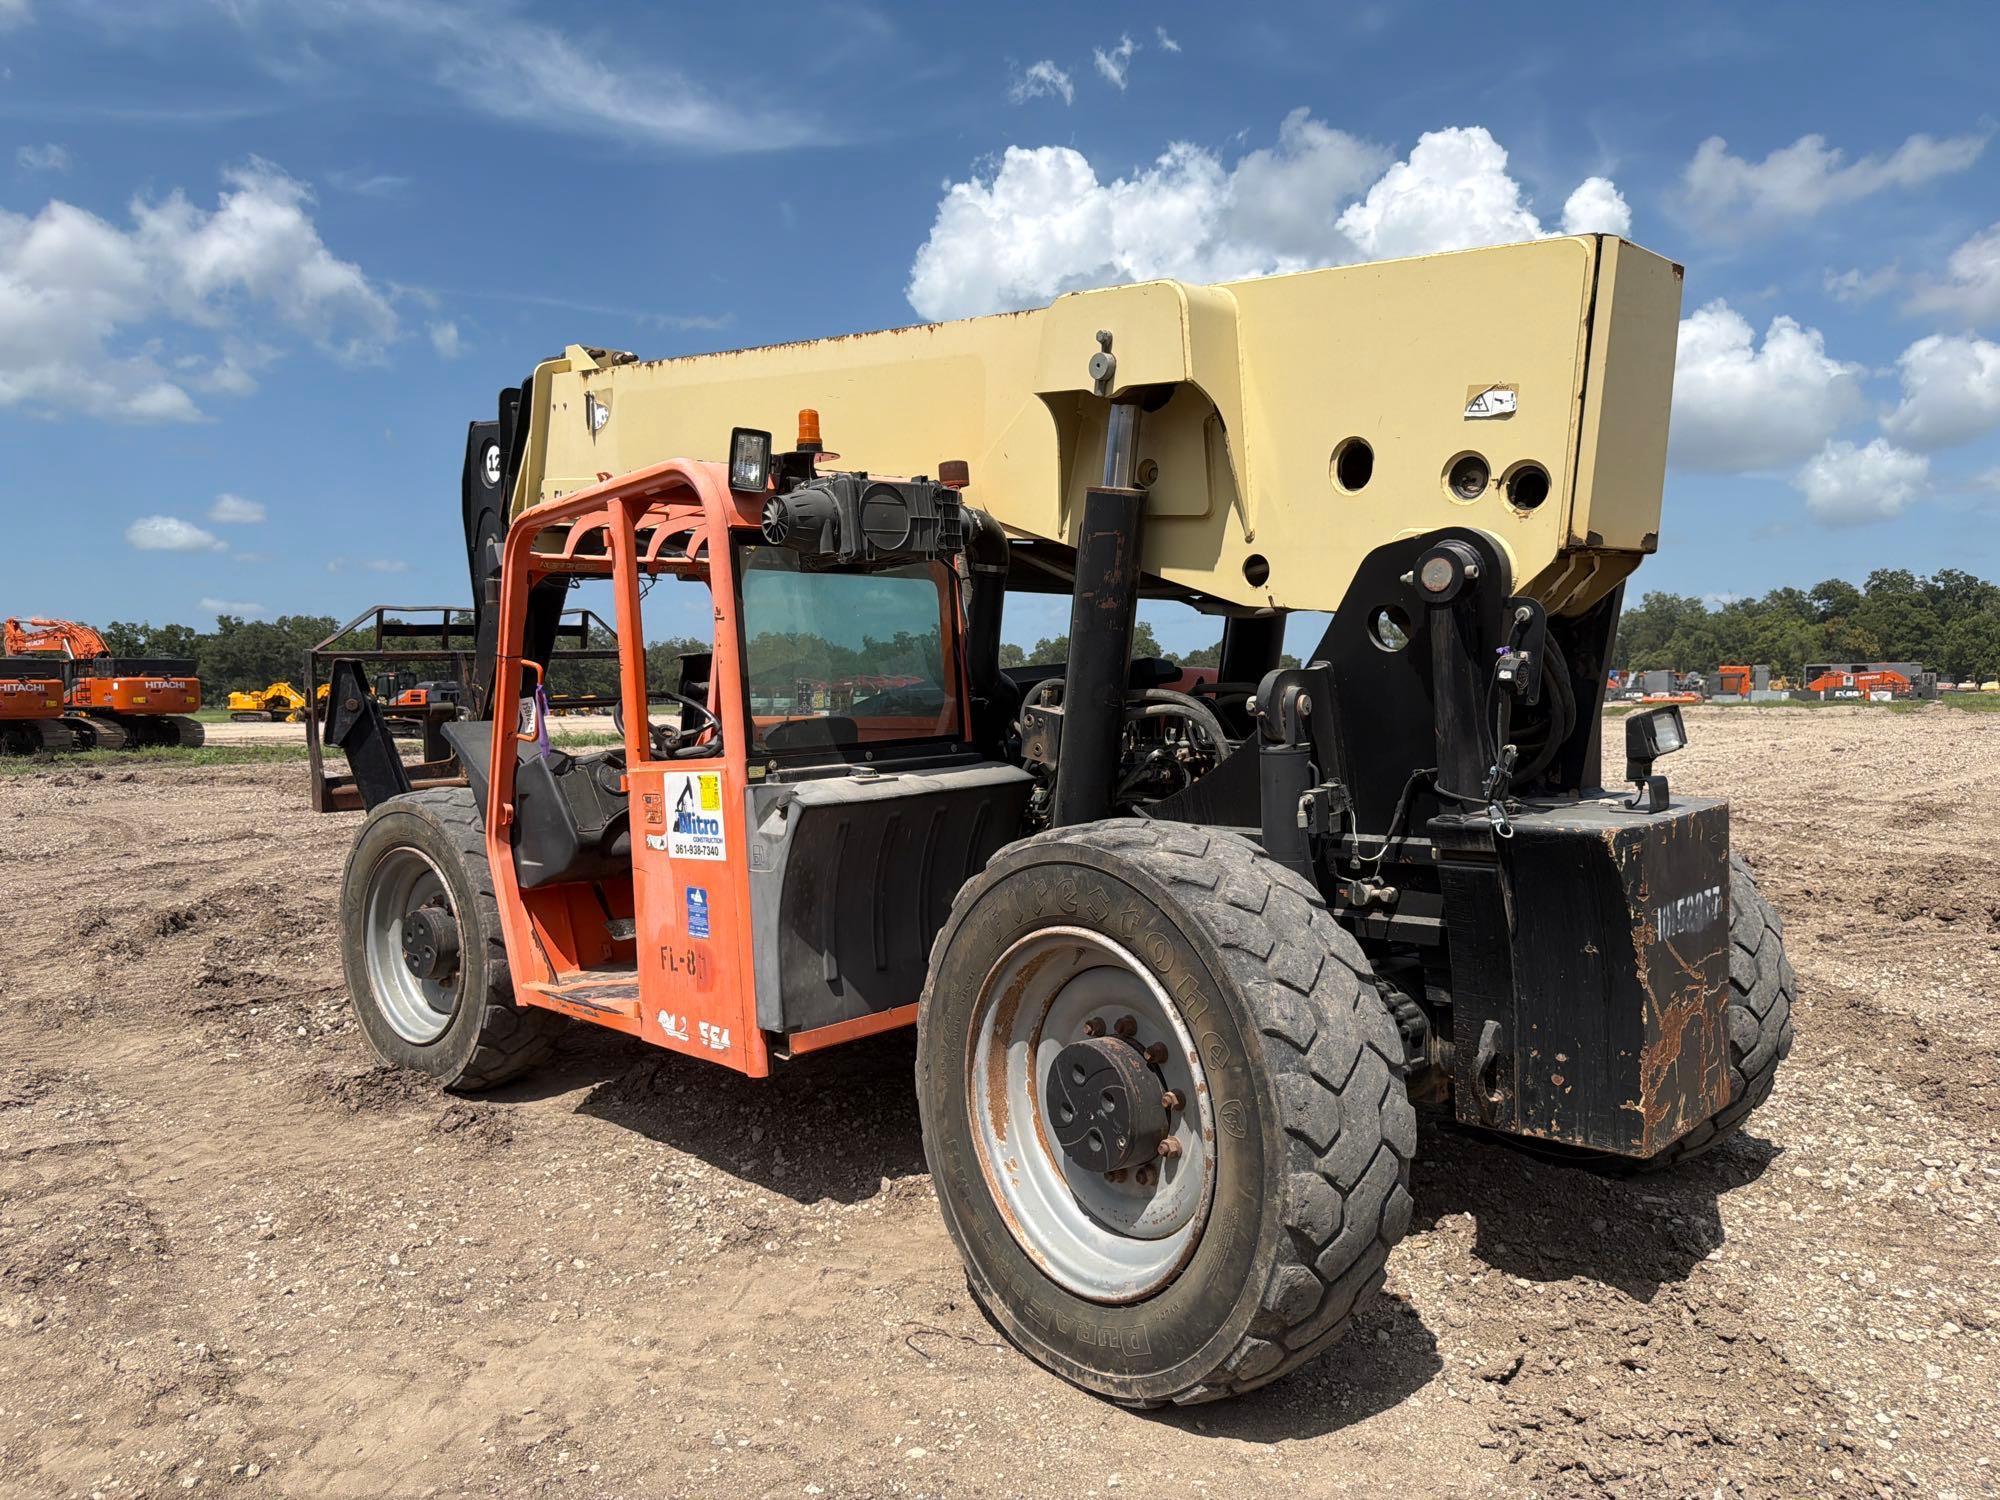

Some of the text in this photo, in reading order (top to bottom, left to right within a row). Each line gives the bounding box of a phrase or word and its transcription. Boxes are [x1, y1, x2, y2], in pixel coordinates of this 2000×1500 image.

[145, 681, 186, 689] HITACHI
[678, 811, 720, 836] Nitro
[692, 836, 723, 844] CONSTRUCTION
[675, 844, 719, 857] 361-938-7340
[978, 876, 1232, 1072] Firestone
